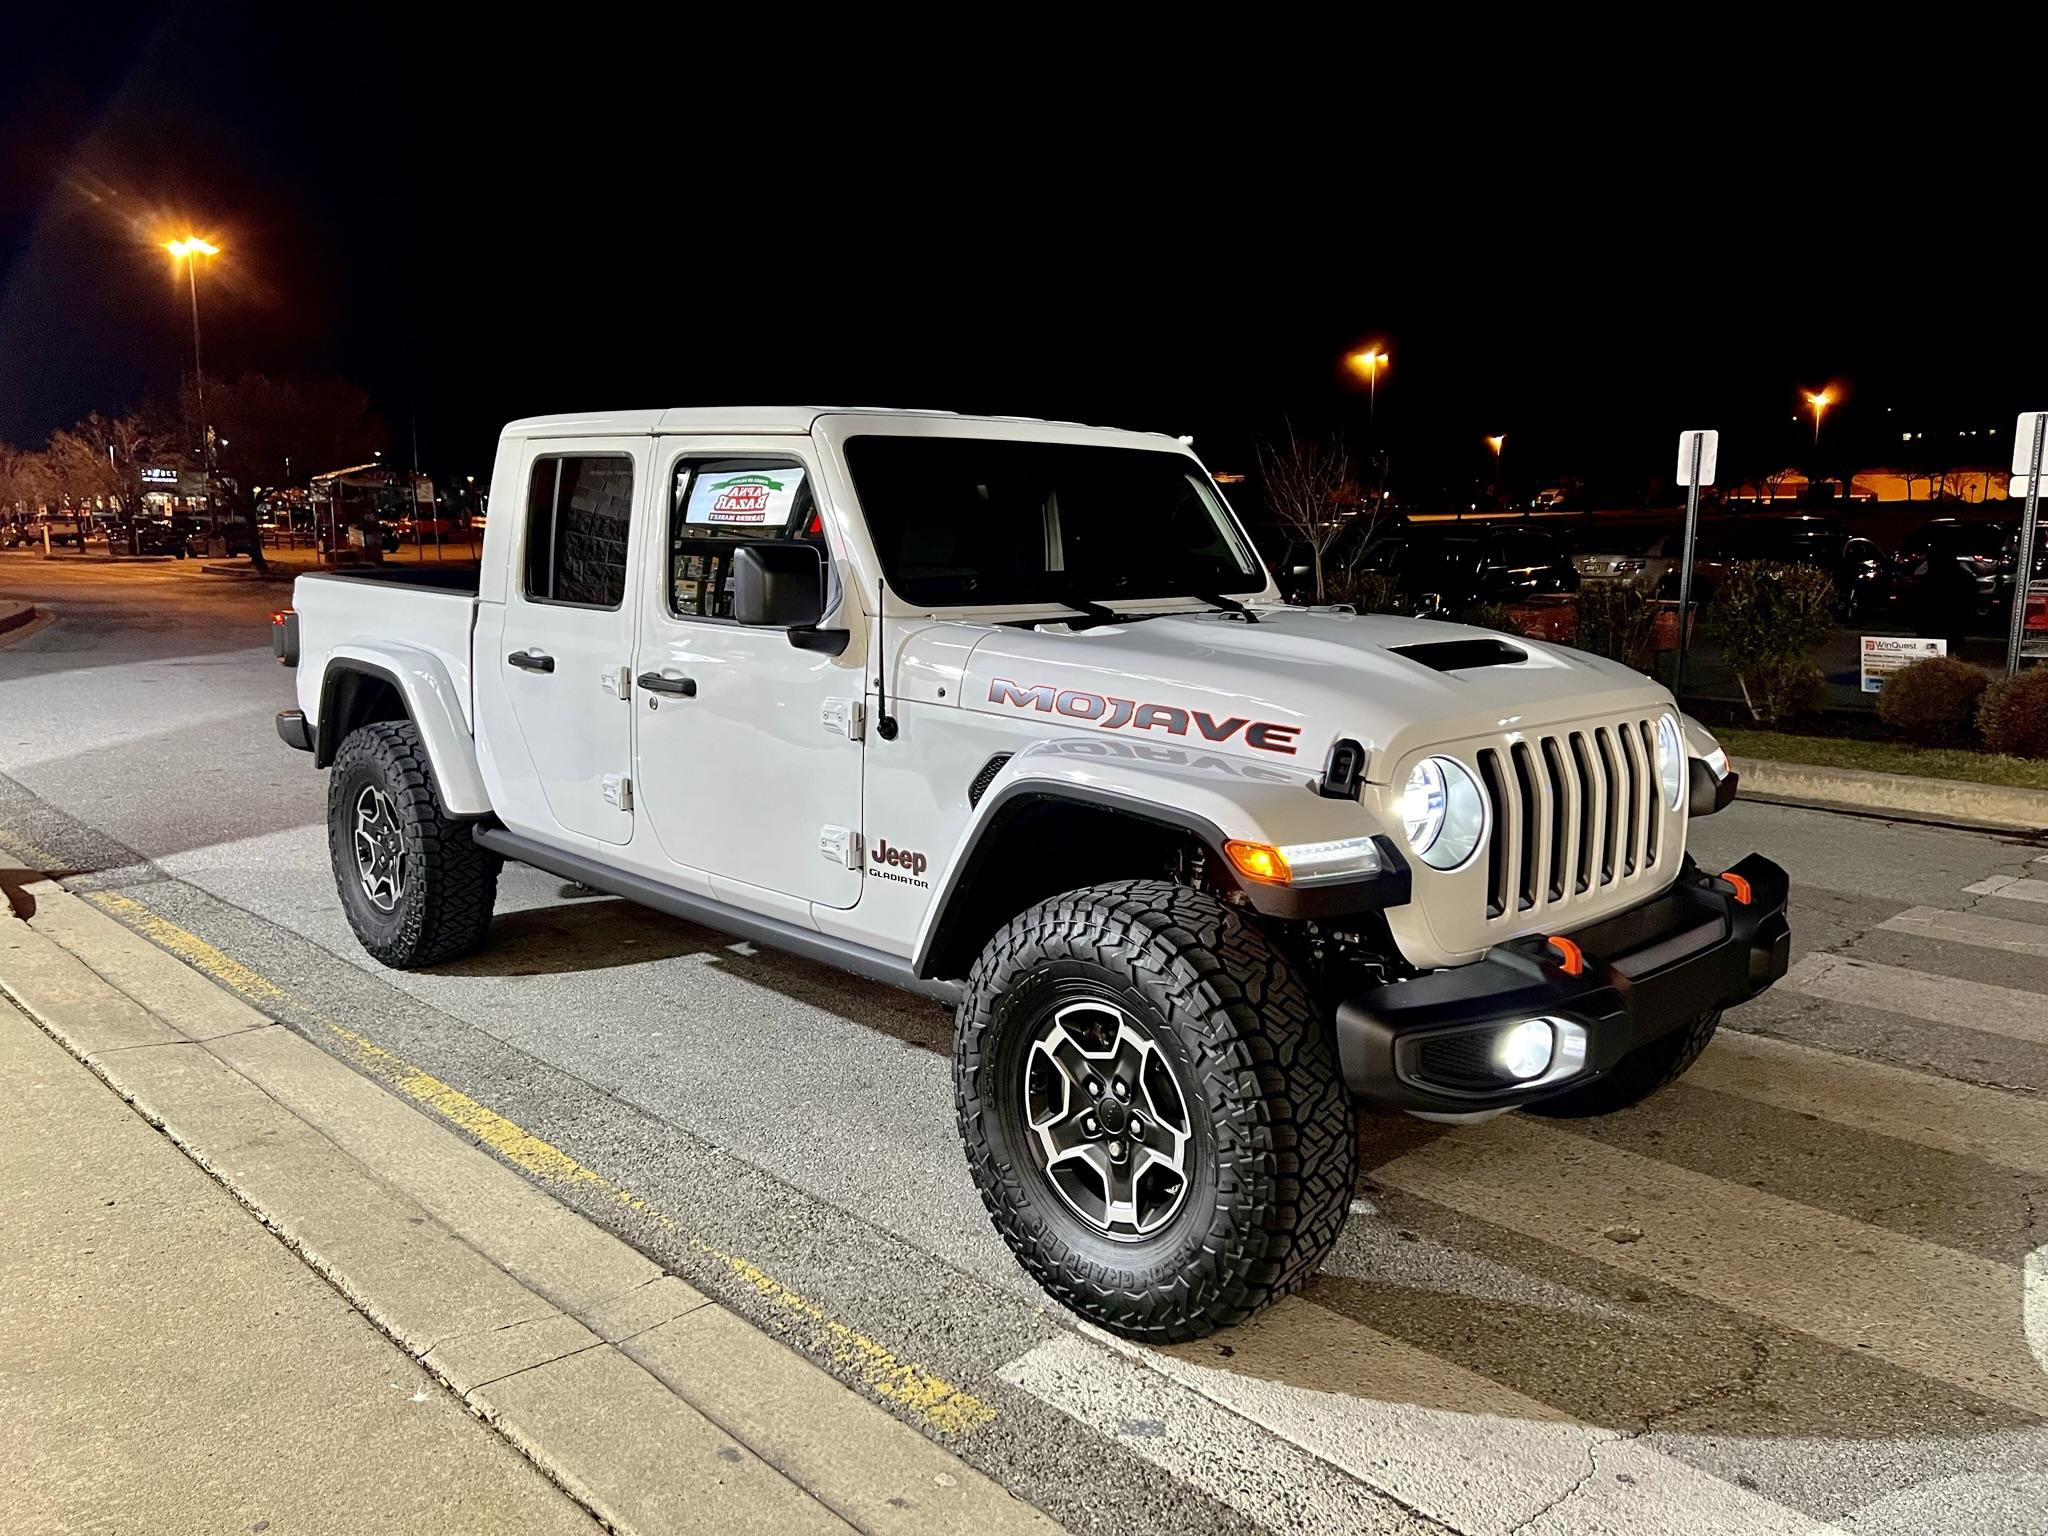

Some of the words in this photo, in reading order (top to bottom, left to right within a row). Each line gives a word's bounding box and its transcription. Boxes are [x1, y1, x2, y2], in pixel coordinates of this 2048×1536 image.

[1875, 641, 1917, 649] WinQuest
[987, 677, 1302, 756] MOJAVE
[871, 838, 928, 877] Jeep
[869, 868, 929, 889] GLADIATOR
